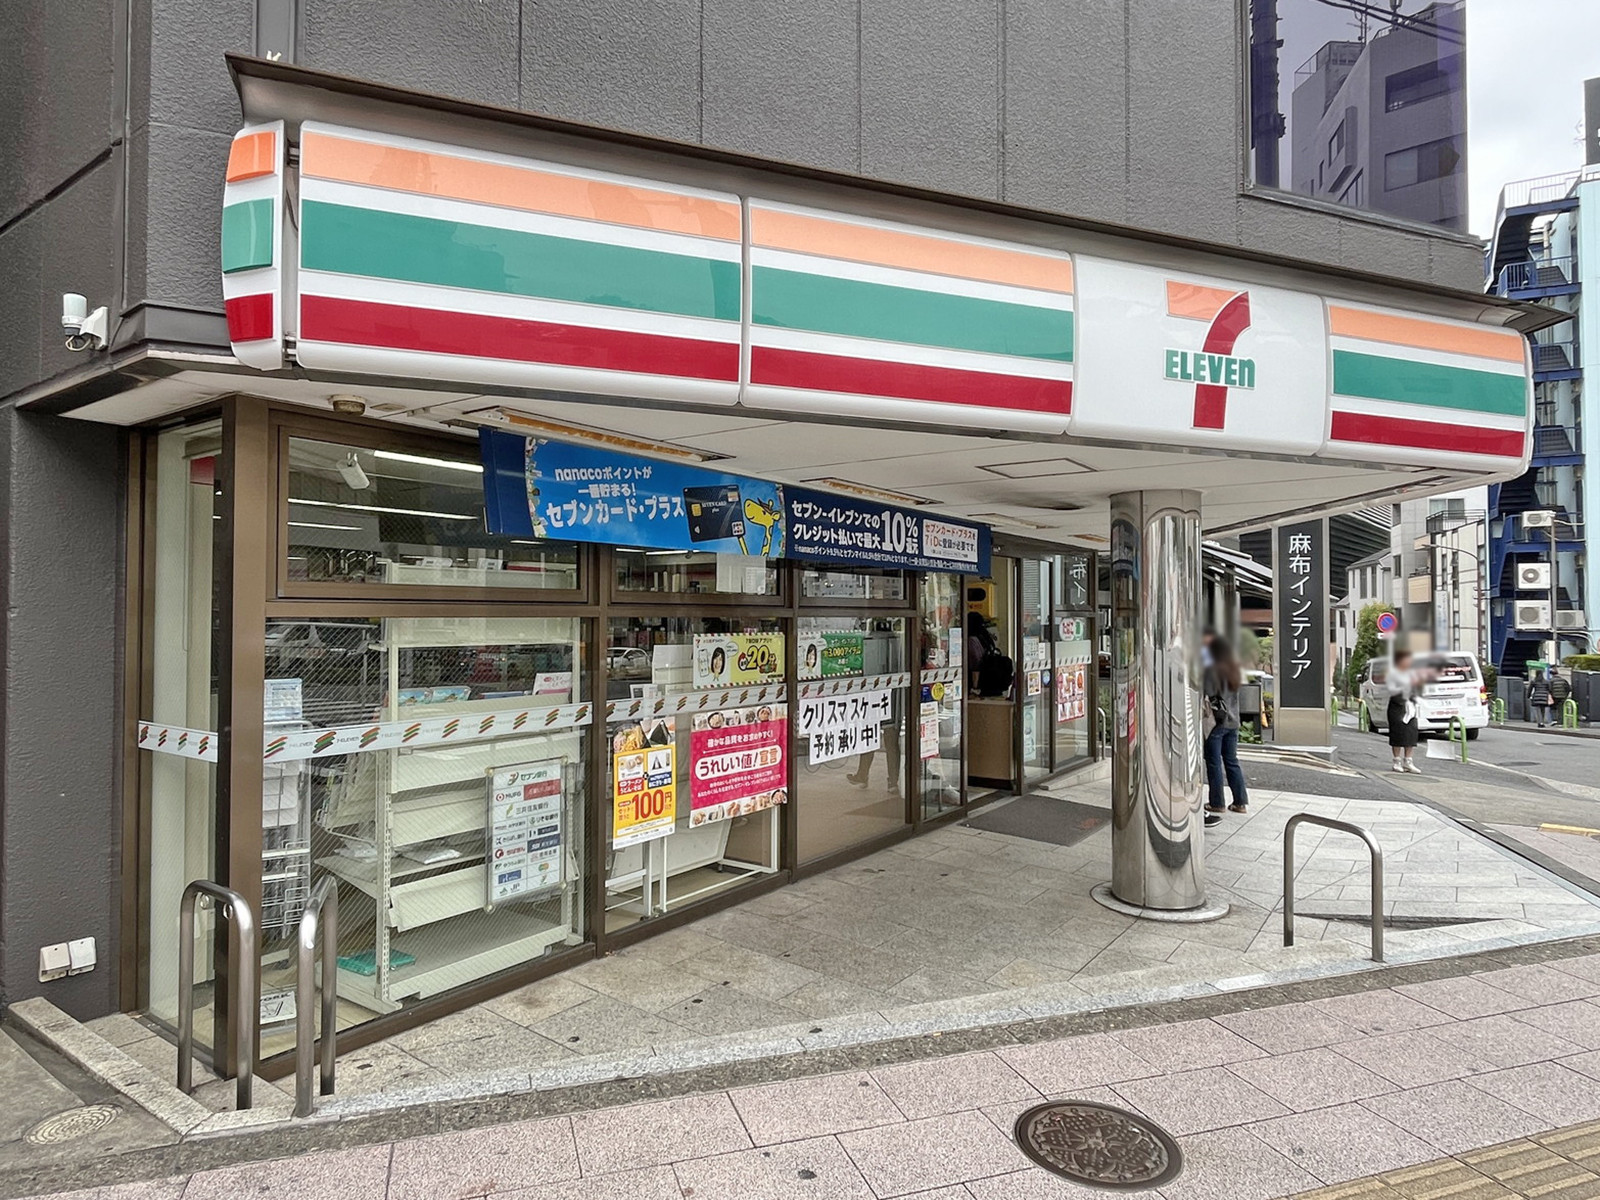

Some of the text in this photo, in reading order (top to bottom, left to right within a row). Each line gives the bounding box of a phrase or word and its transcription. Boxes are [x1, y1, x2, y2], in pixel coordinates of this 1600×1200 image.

[554, 466, 653, 481] nanacoポイントが
[546, 495, 685, 528] セブンカード・プラス
[793, 523, 881, 550] クレジット払いで最大
[1288, 533, 1312, 680] 麻布インテリア
[803, 693, 890, 730] クリスマスケーキ
[814, 723, 878, 758] 予約承り中!
[505, 790, 522, 799] MUFG
[632, 789, 672, 820] 100 円
